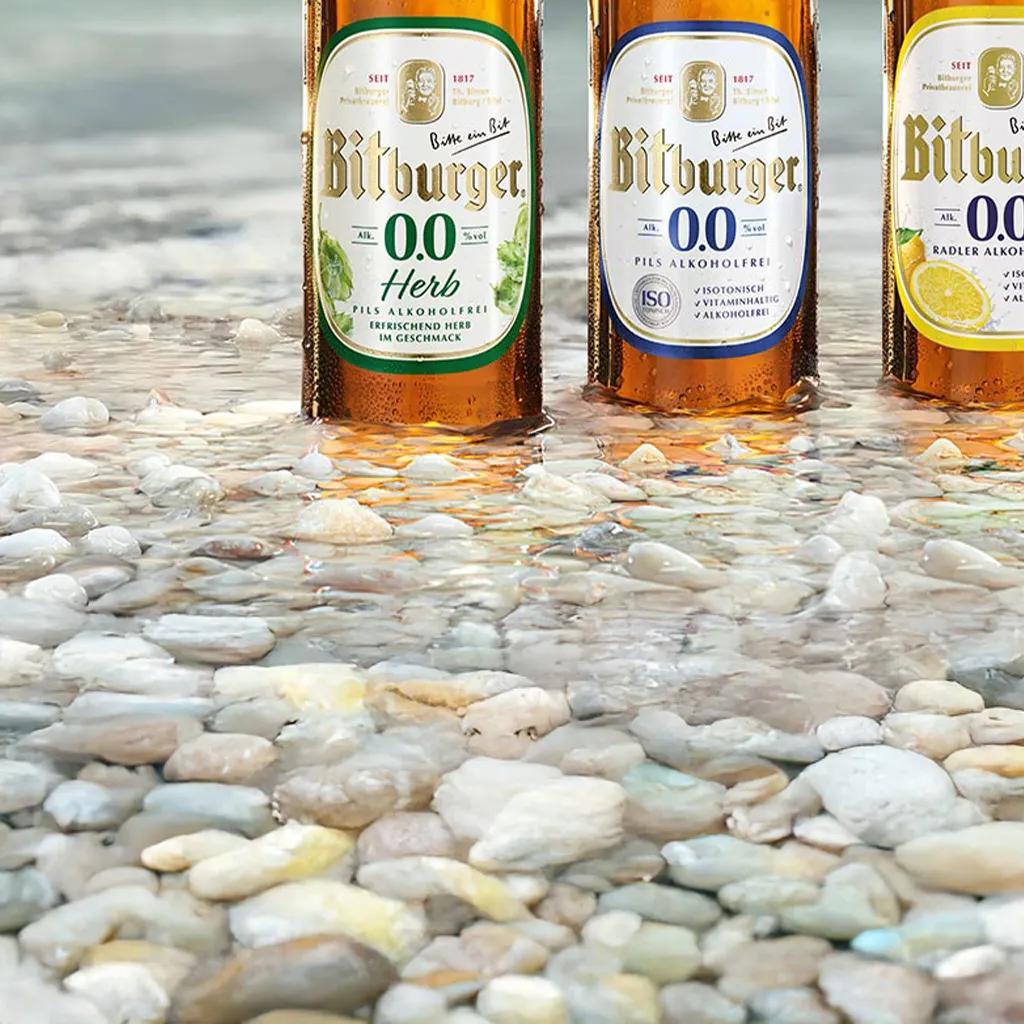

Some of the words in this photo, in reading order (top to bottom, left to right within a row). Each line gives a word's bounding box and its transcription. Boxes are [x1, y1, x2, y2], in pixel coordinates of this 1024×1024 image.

[951, 62, 971, 70] SEIT
[368, 74, 389, 83] SEIT
[452, 74, 475, 83] 1817
[653, 75, 674, 83] SEIT
[733, 75, 755, 83] 1817
[430, 131, 463, 150] Bitte
[468, 131, 486, 141] ein
[489, 117, 510, 134] Bit
[711, 129, 742, 147] Bitte
[747, 128, 765, 138] ein
[767, 115, 788, 132] Bit
[320, 128, 523, 211] Bitburger
[608, 125, 800, 205] Bitburger
[940, 213, 957, 222] Alk.
[642, 223, 660, 232] Alk.
[668, 206, 736, 252] 0.0
[357, 231, 375, 240] Alk.
[384, 213, 456, 261] 0.0
[932, 245, 979, 256] RADLER
[634, 257, 662, 267] PILS
[669, 257, 770, 269] ALKOHOLFREI
[380, 268, 461, 302] Herb
[702, 285, 764, 295] ISOTONISCH
[642, 290, 671, 307] ISO
[703, 295, 780, 307] VITAMINHALTIG
[352, 305, 380, 315] PILS
[389, 305, 488, 316] ALKOHOLFREI
[702, 308, 770, 319] ALKOHOLFREI
[369, 321, 441, 331] ERFRISCHEND
[445, 321, 471, 330] HERB
[379, 333, 392, 342] IM
[396, 333, 462, 343] GESCHMACK
